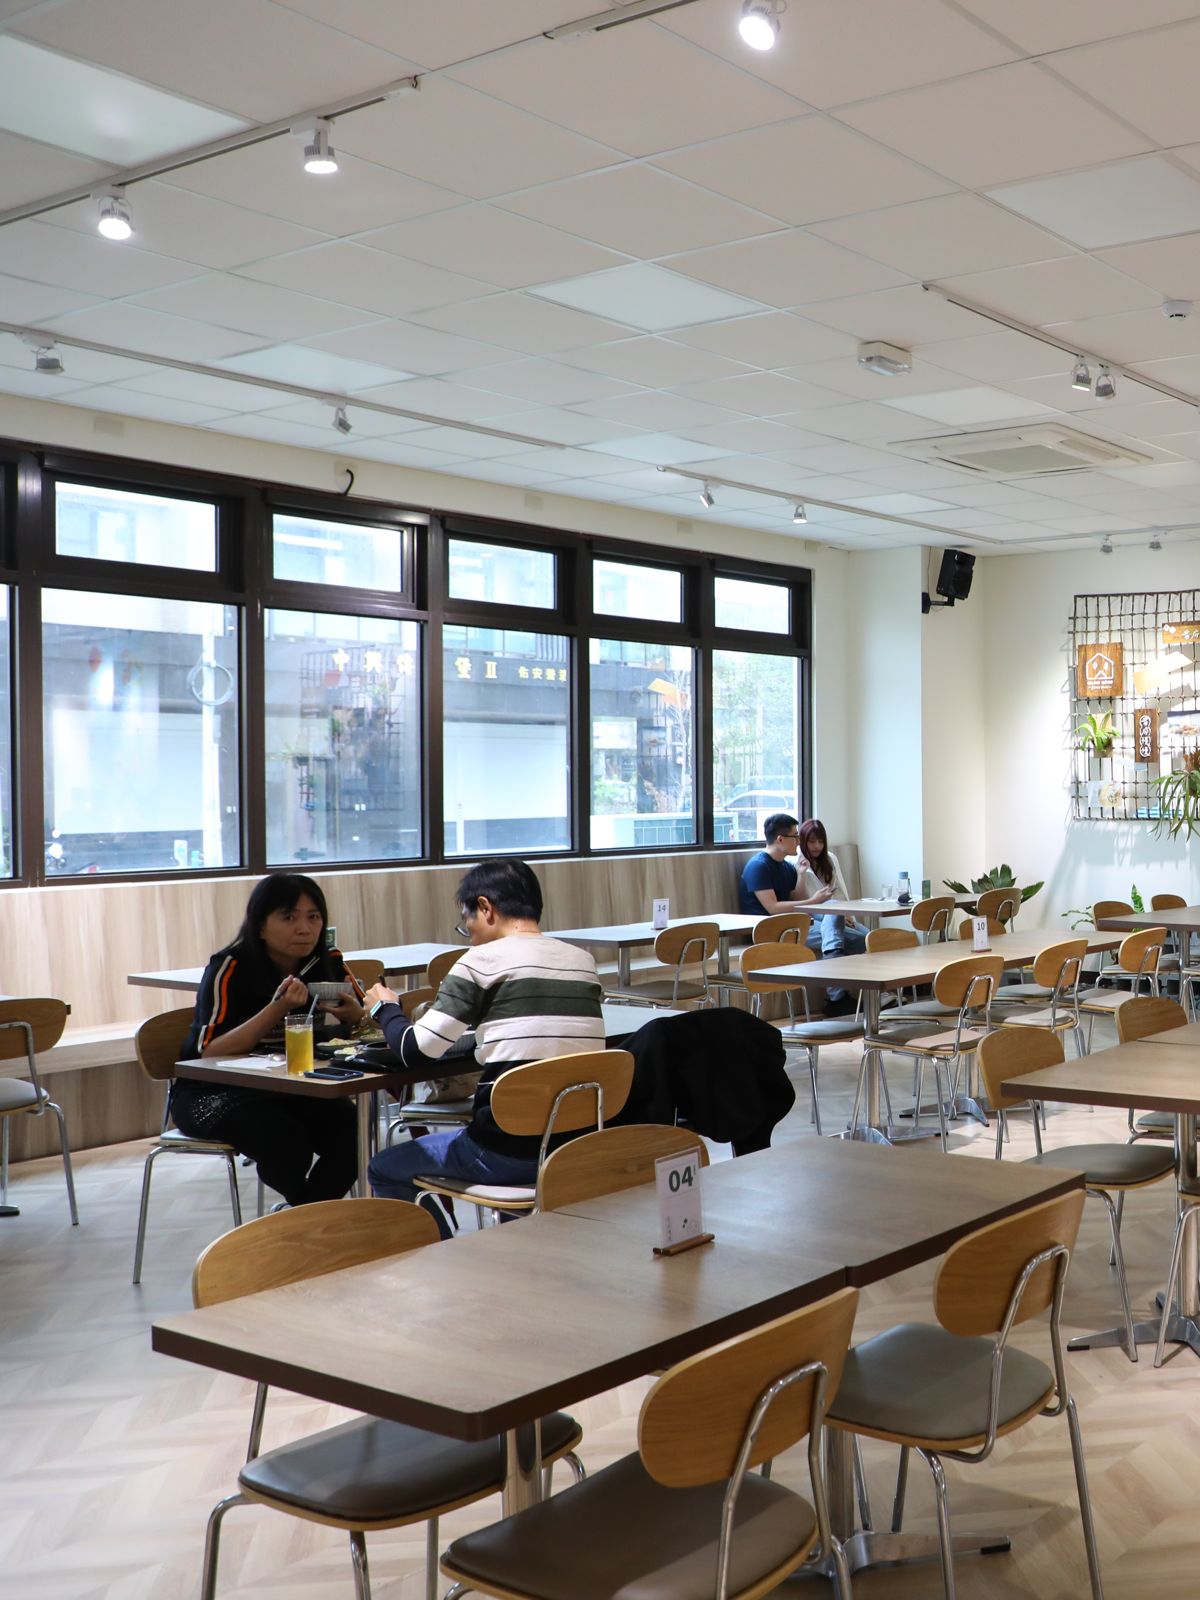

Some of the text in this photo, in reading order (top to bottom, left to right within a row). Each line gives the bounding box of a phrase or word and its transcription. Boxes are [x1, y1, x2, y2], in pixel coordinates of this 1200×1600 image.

[658, 904, 666, 912] 14
[977, 921, 986, 931] 10
[668, 1165, 694, 1193] 04
